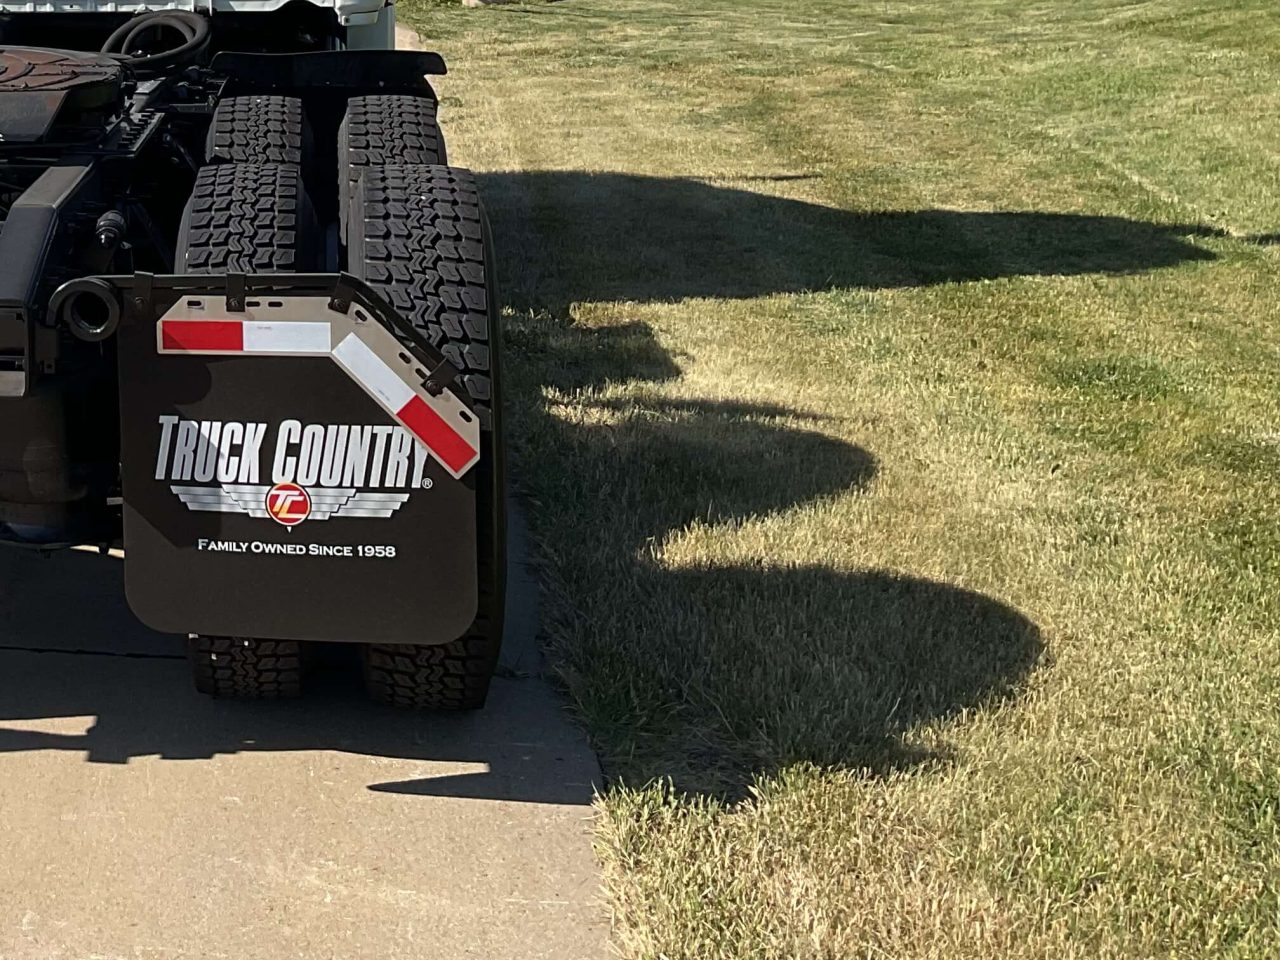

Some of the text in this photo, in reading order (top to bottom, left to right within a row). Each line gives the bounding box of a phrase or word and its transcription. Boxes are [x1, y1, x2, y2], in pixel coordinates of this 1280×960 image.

[154, 415, 268, 484] TRUCK
[198, 538, 397, 558] FAMILY OWNED SINCE 1958
